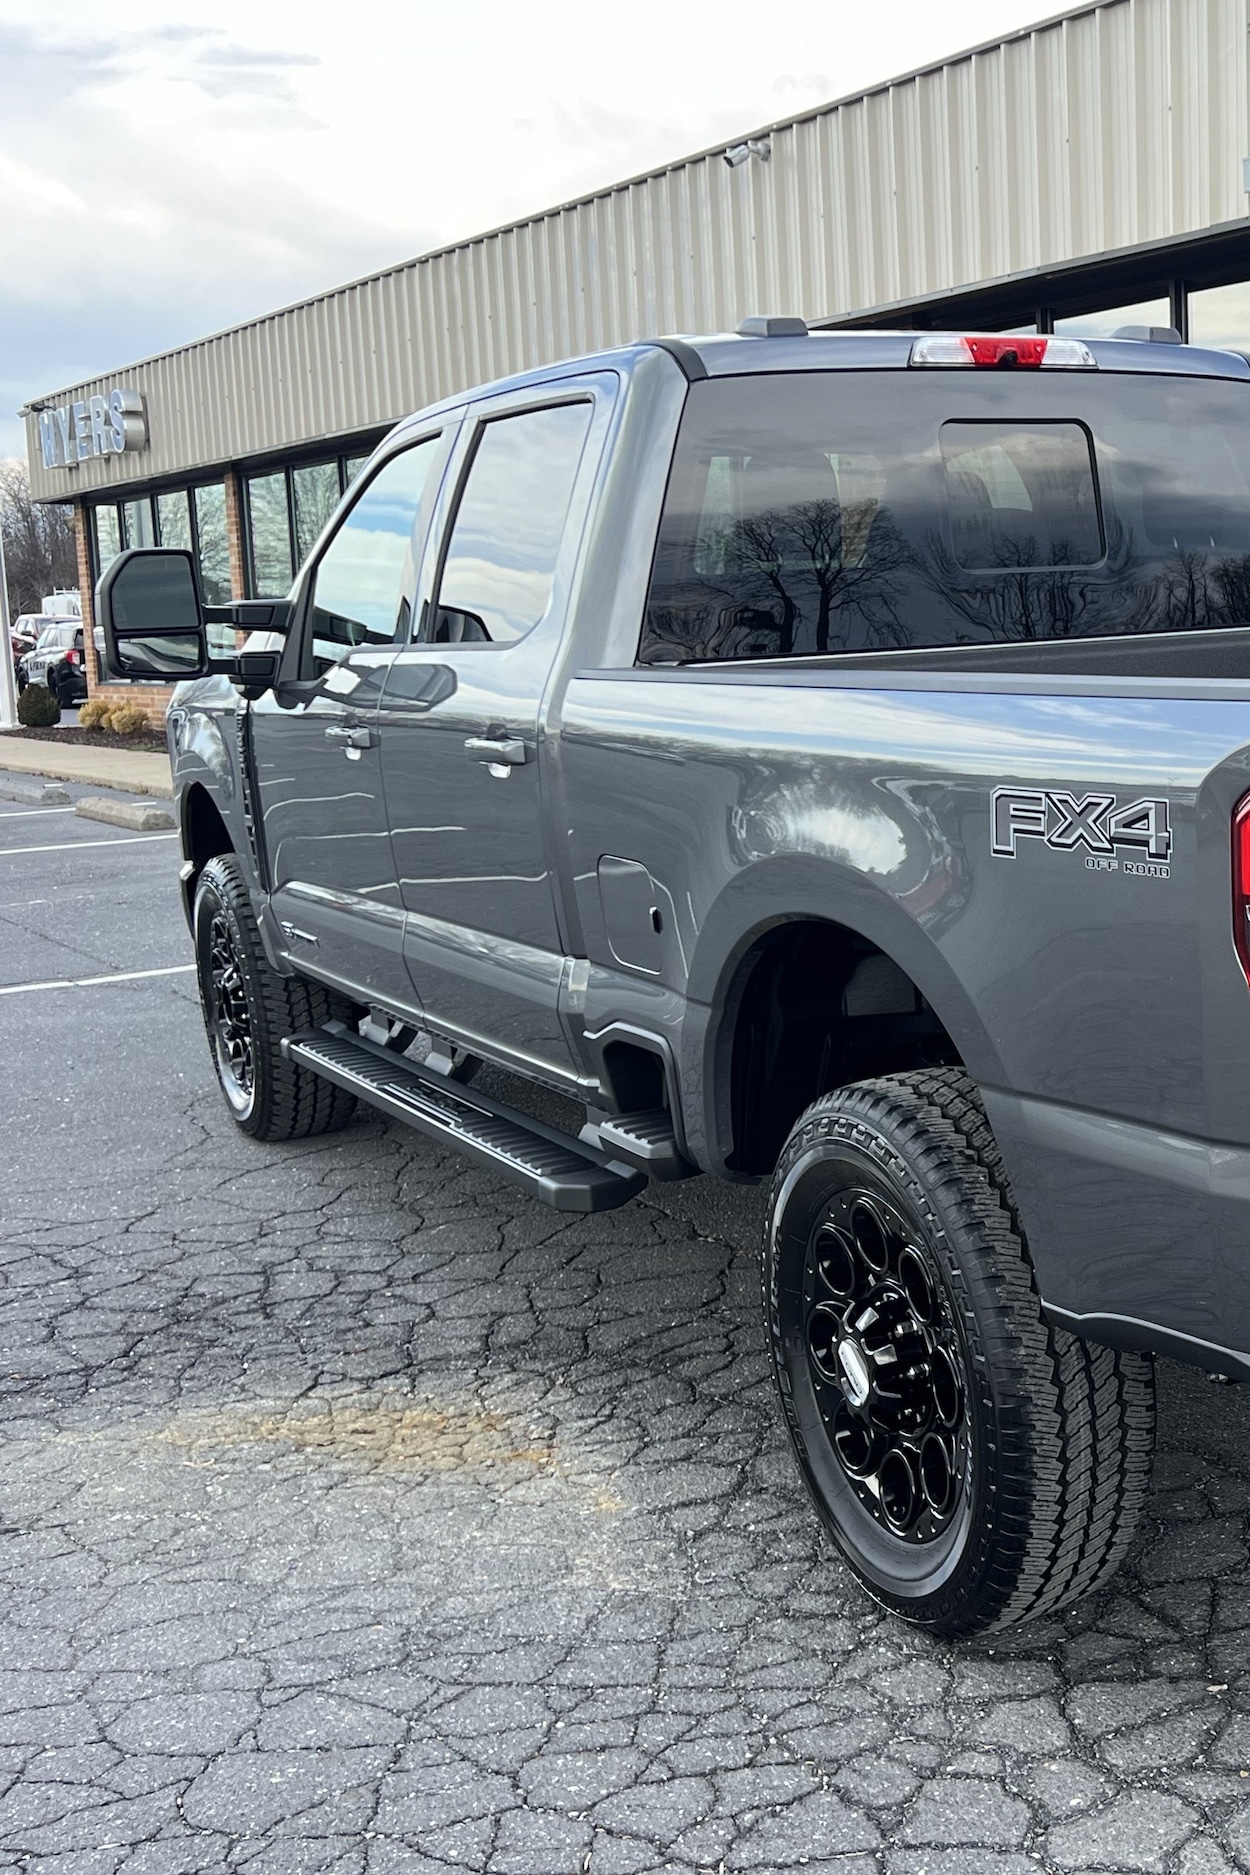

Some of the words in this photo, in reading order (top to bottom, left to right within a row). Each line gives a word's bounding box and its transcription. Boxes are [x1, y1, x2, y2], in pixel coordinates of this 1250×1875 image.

[39, 389, 130, 469] MYERS
[990, 785, 1173, 862] FX4
[1085, 857, 1119, 872] OFF
[1123, 861, 1171, 879] ROAD
